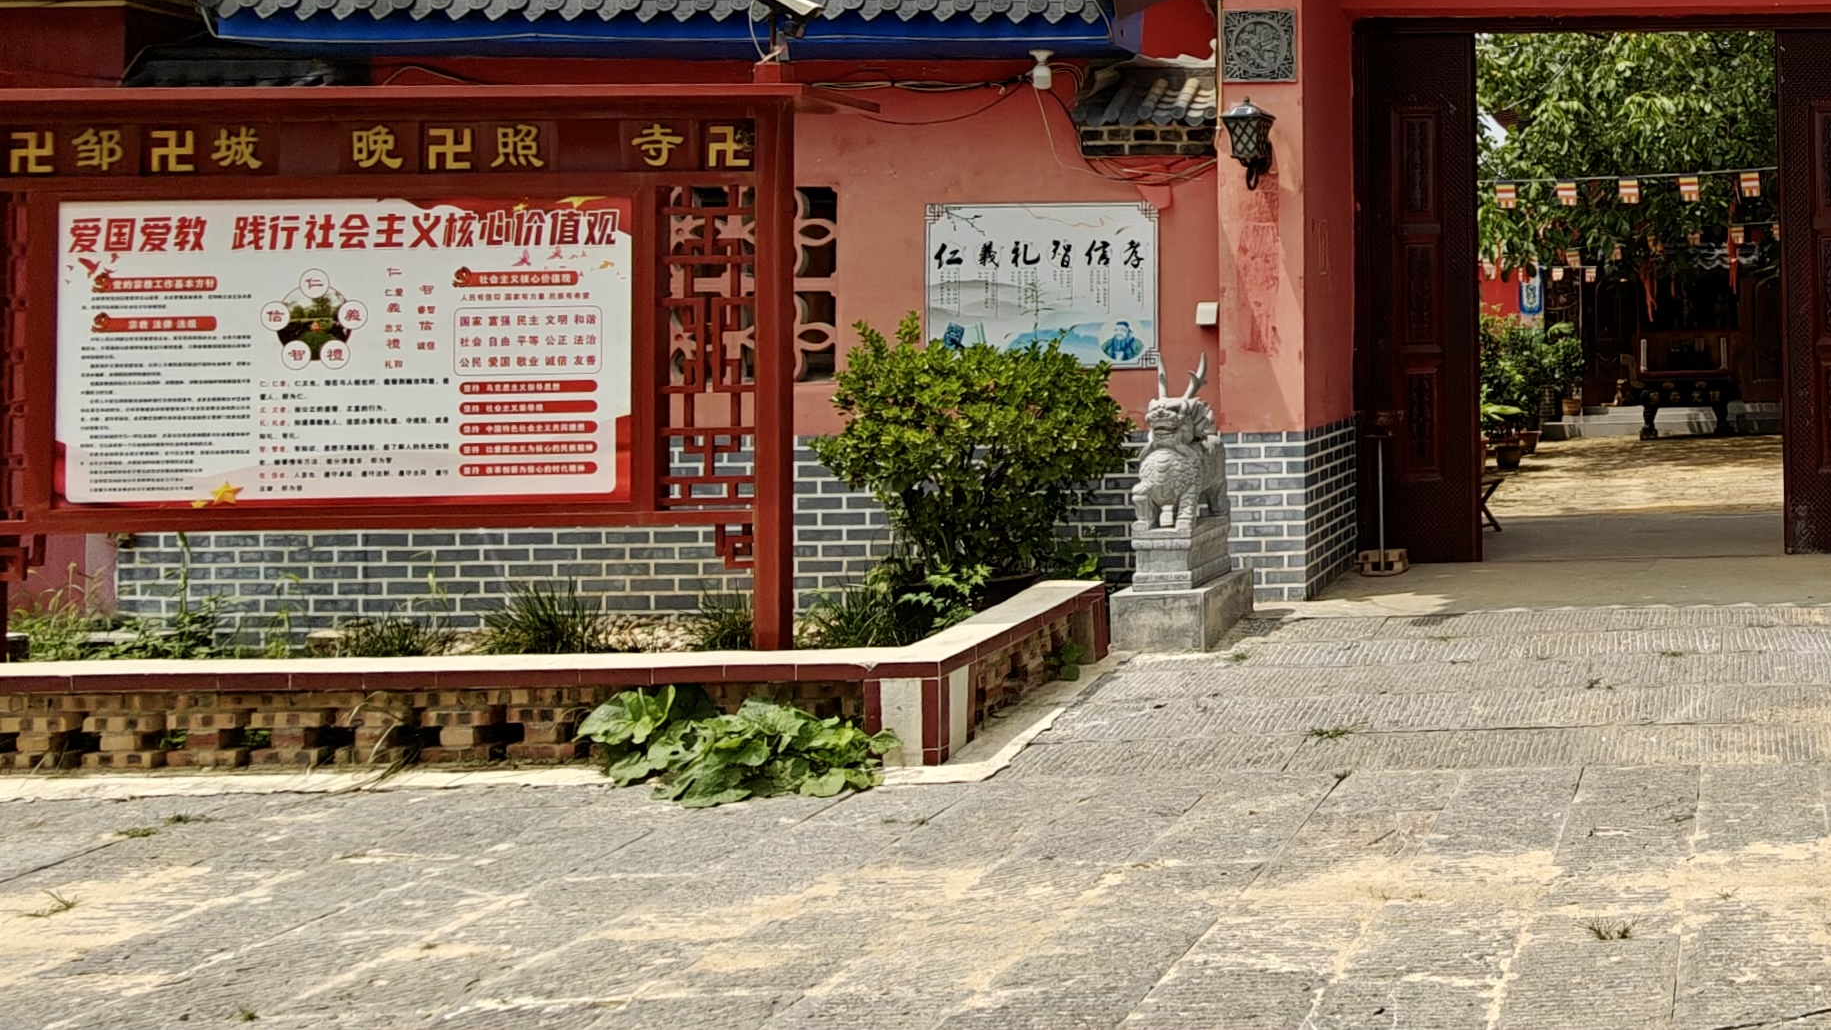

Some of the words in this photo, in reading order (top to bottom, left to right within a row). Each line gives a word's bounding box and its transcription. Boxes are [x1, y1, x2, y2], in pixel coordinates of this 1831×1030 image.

[68, 216, 207, 253] 爱国爱教
[231, 208, 620, 251] 践行社会主义核心价值观
[387, 267, 402, 277] 仁
[112, 278, 215, 290] 党的宗教工作基本方针
[305, 278, 323, 290] 仁
[479, 273, 572, 284] 社会主义核心价值观
[384, 288, 404, 297] 仁爱
[460, 293, 501, 301] 人民有信仰
[504, 293, 545, 301] 国家有力量
[549, 292, 590, 300] 民族有希望
[266, 310, 285, 322] 信
[460, 316, 482, 326] 国家
[488, 316, 511, 326] 富强
[517, 315, 540, 326] 民主
[545, 314, 568, 325] 文明
[574, 314, 596, 324] 和谐
[418, 321, 434, 331] 信
[460, 336, 482, 347] 社会
[489, 336, 510, 346] 自由
[517, 335, 539, 346] 平等
[545, 335, 568, 345] 公正
[574, 334, 596, 345] 法治
[460, 357, 482, 367] 公民
[488, 356, 510, 367] 爱国
[517, 356, 539, 366] 敬业
[545, 356, 567, 366] 诚信
[573, 355, 596, 365] 友善
